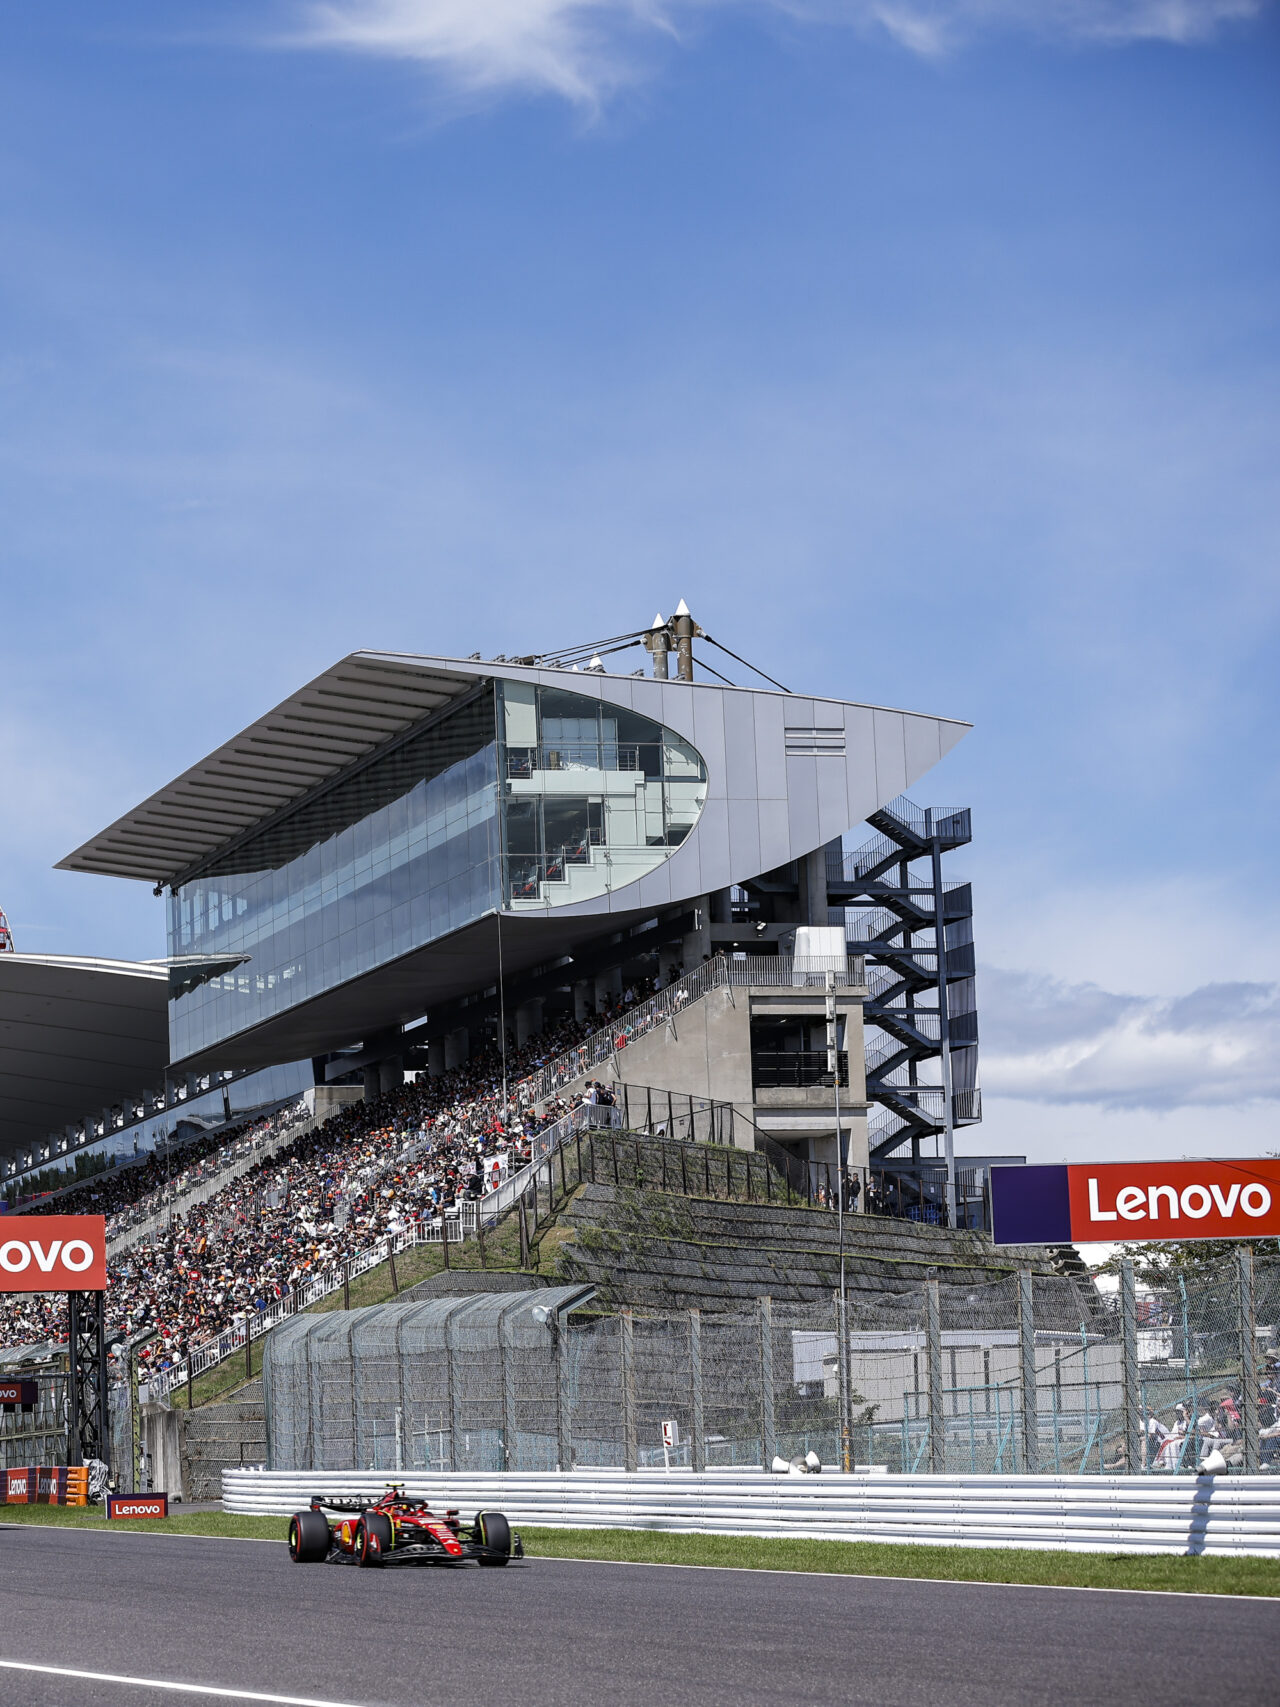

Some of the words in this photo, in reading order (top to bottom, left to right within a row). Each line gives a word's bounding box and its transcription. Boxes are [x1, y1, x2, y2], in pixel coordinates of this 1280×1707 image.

[1088, 1178, 1271, 1222] Lenovo
[8, 1476, 27, 1496] Lenovo
[37, 1473, 57, 1495] Lenovo
[115, 1504, 160, 1515] Lenovo
